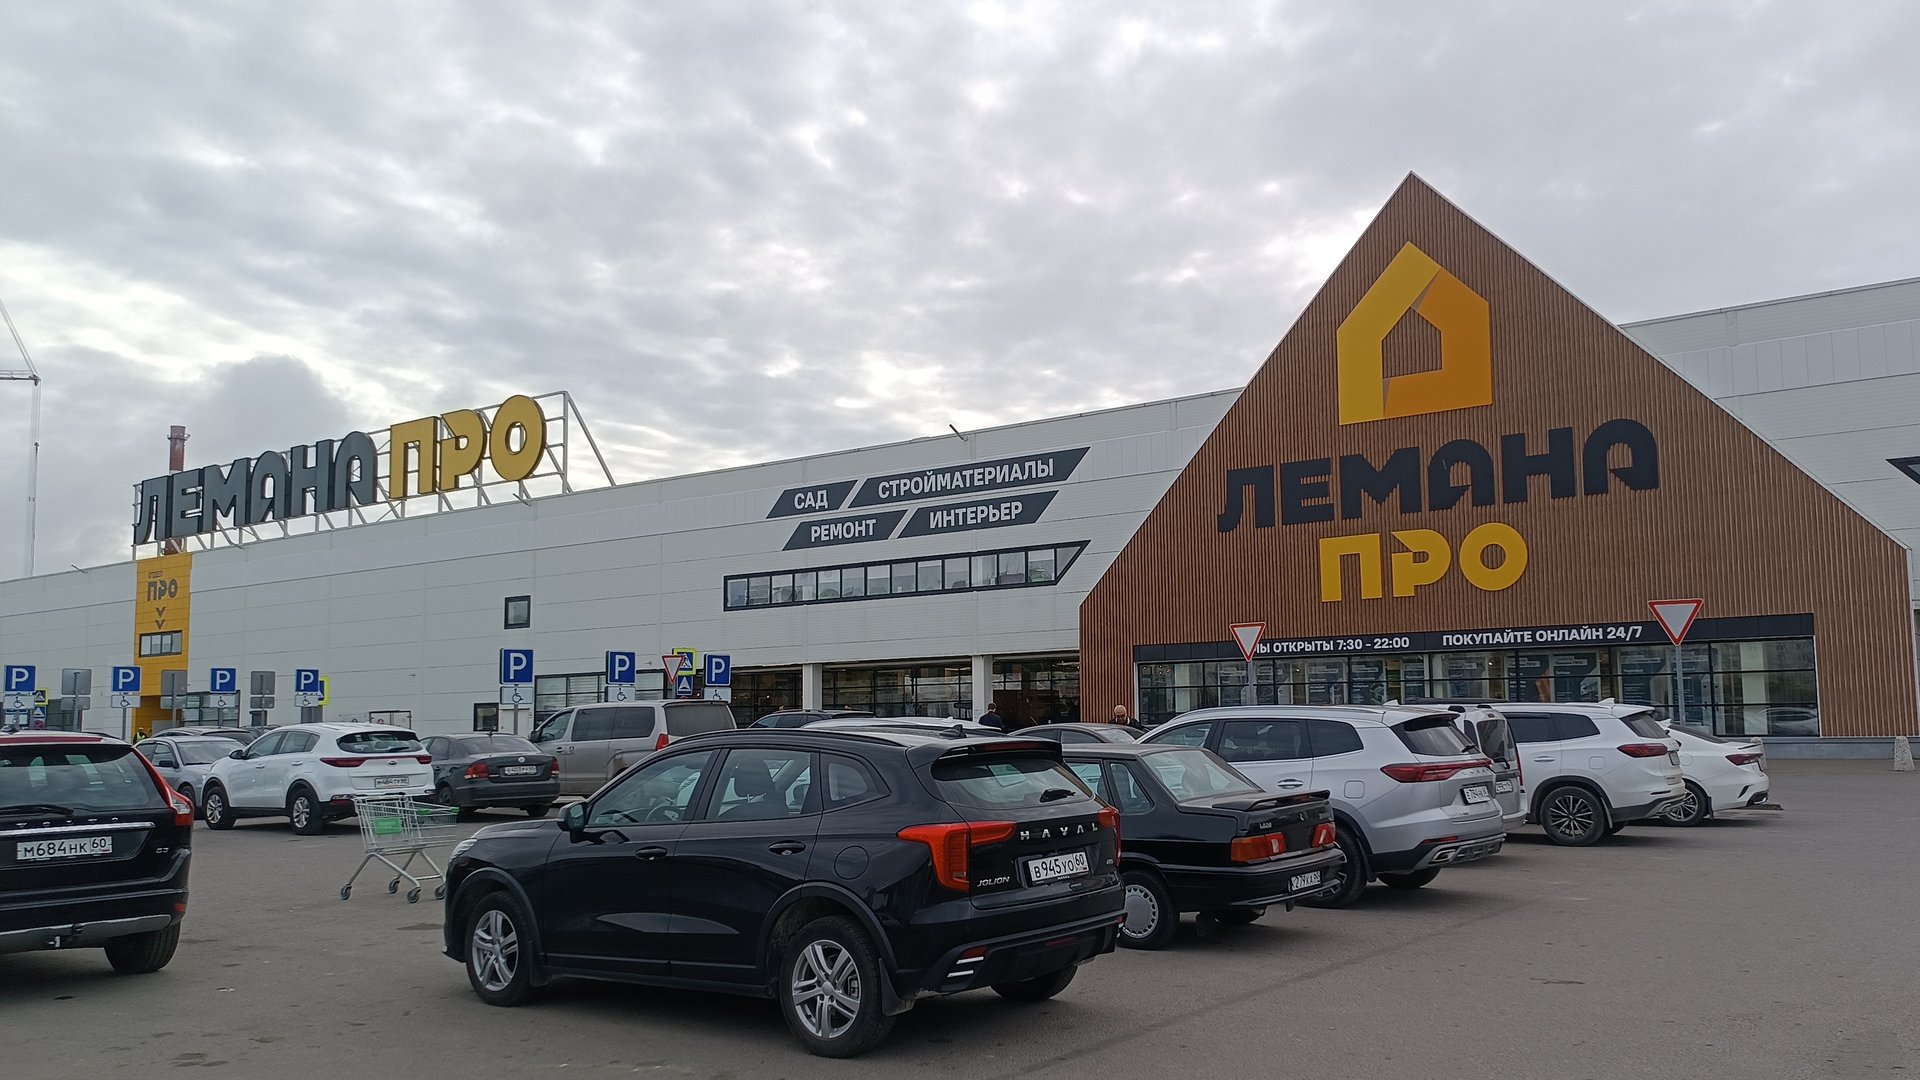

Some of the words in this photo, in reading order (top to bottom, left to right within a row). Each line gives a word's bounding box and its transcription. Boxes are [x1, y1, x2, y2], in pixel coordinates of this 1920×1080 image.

[132, 431, 378, 545] ЛЕМАНА
[389, 395, 547, 499] ПРО
[878, 458, 1055, 499] СТРОЙМАТЕРИАЛЫ
[1217, 418, 1660, 533] ЛЕМАНА
[793, 489, 829, 511] САД
[929, 501, 1023, 529] ИНТЕРЬЕР
[811, 518, 877, 542] РЕМОНТ
[1319, 522, 1528, 603] ПРО
[147, 578, 178, 601] ПРО
[1273, 640, 1334, 653] ОТКРЫТЫ
[1338, 638, 1363, 650] 7:30
[1374, 635, 1410, 648] 22:00
[1442, 628, 1532, 646] ПОКУПАЙТЕ
[1535, 625, 1604, 643] ОНЛАЙН
[1607, 624, 1643, 641] 24/7
[509, 652, 527, 679] P
[614, 655, 630, 680] P
[711, 658, 726, 682] P
[11, 667, 29, 690] P
[118, 669, 135, 690] P
[216, 670, 231, 690] P
[301, 671, 314, 690] P
[1019, 822, 1099, 841] HAVAL
[23, 841, 88, 857] М684НК
[91, 838, 107, 849] 60
[1033, 858, 1074, 879] В945УО
[1074, 853, 1085, 867] 60
[976, 876, 1011, 888] JOLION
